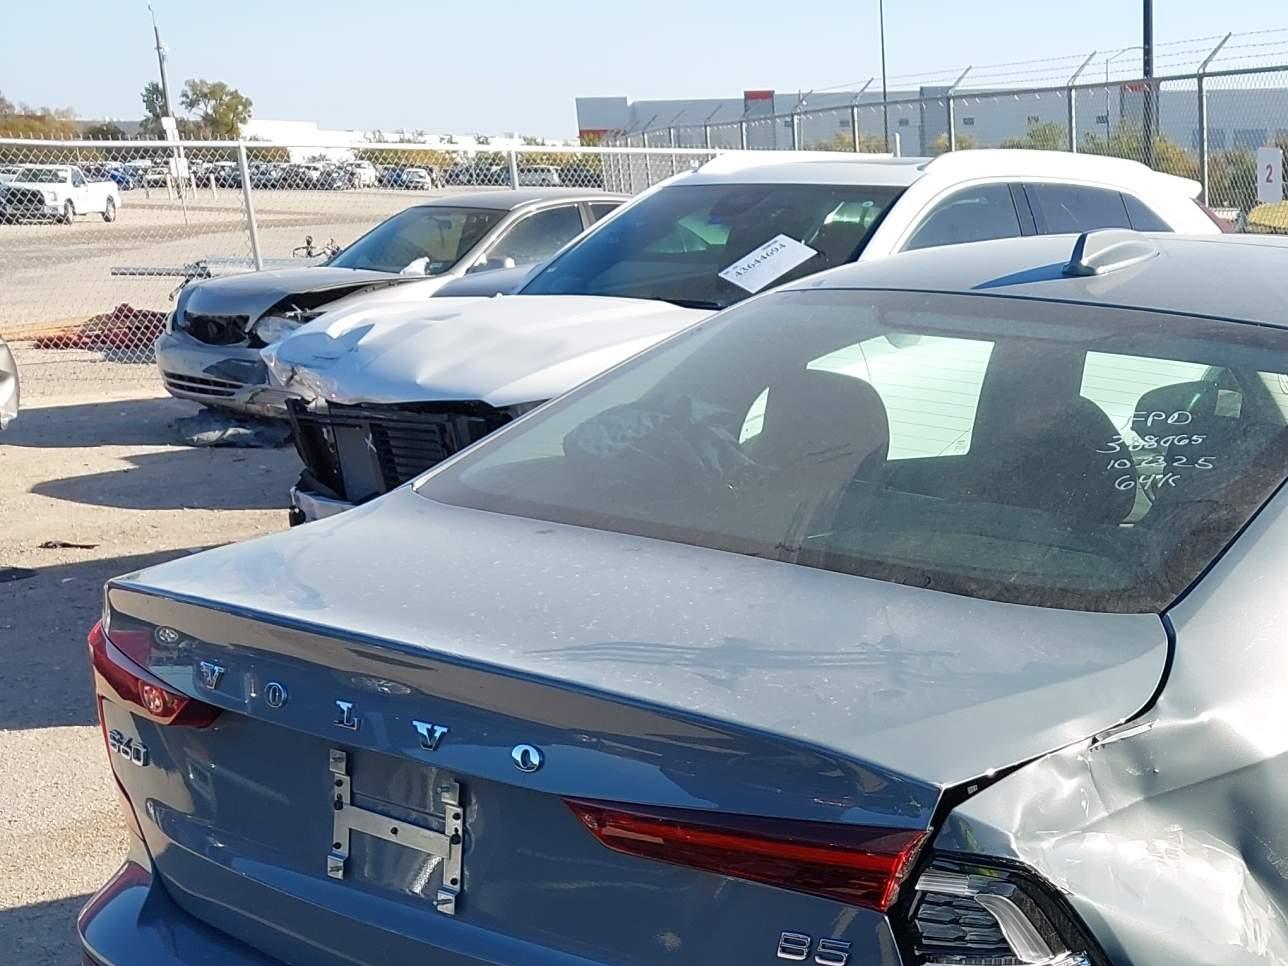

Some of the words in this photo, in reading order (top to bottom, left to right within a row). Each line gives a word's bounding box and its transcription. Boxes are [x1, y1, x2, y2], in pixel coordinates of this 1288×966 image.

[1265, 163, 1274, 184] 2
[200, 660, 544, 774] VOLVO
[777, 931, 852, 966] B5
